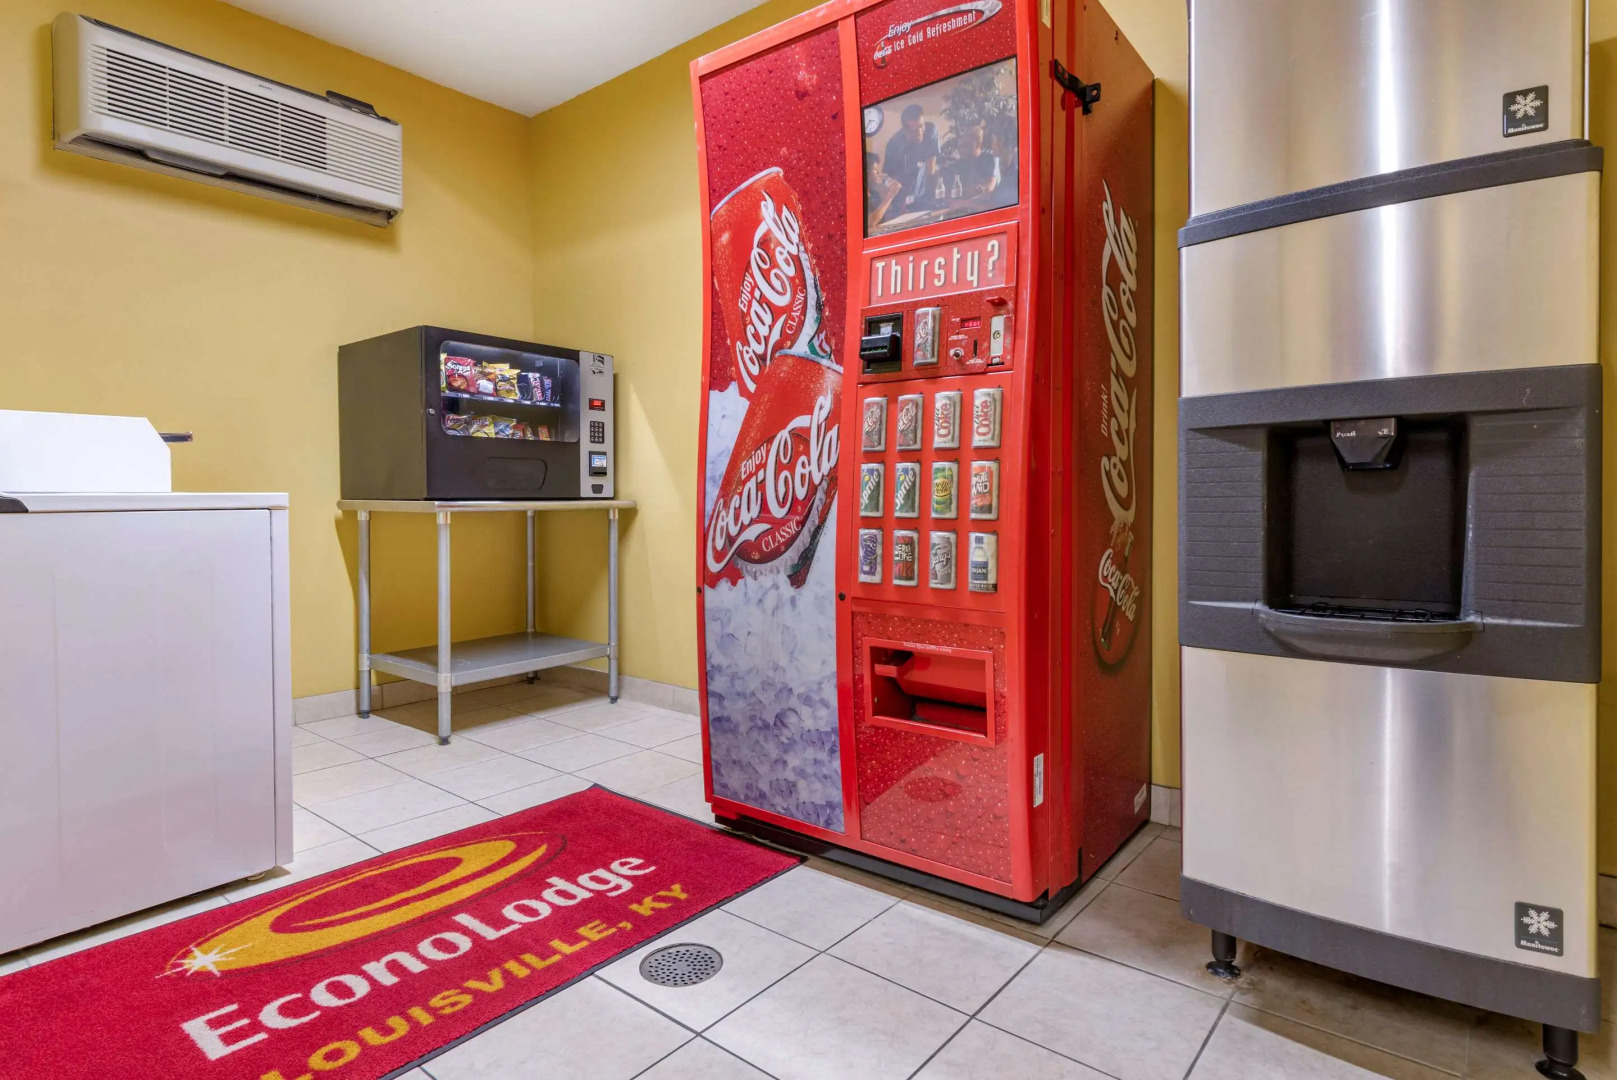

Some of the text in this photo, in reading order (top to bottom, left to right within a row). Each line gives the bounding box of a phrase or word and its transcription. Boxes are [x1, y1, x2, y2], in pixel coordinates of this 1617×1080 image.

[889, 21, 912, 38] Enjoy
[893, 10, 976, 52] Ice Cold Refreshment
[736, 189, 800, 394] Coca-Cola
[738, 271, 755, 313] Enjoy
[785, 286, 807, 335] CLASSIC
[1101, 178, 1138, 524] Coca-Cola
[706, 385, 840, 573] Coca-Cola
[740, 442, 767, 481] Enjoy
[761, 516, 801, 553] CLASSIC
[1099, 548, 1140, 623] Coca-Cola
[629, 883, 689, 917] KY
[181, 857, 656, 1061] EconoLodge
